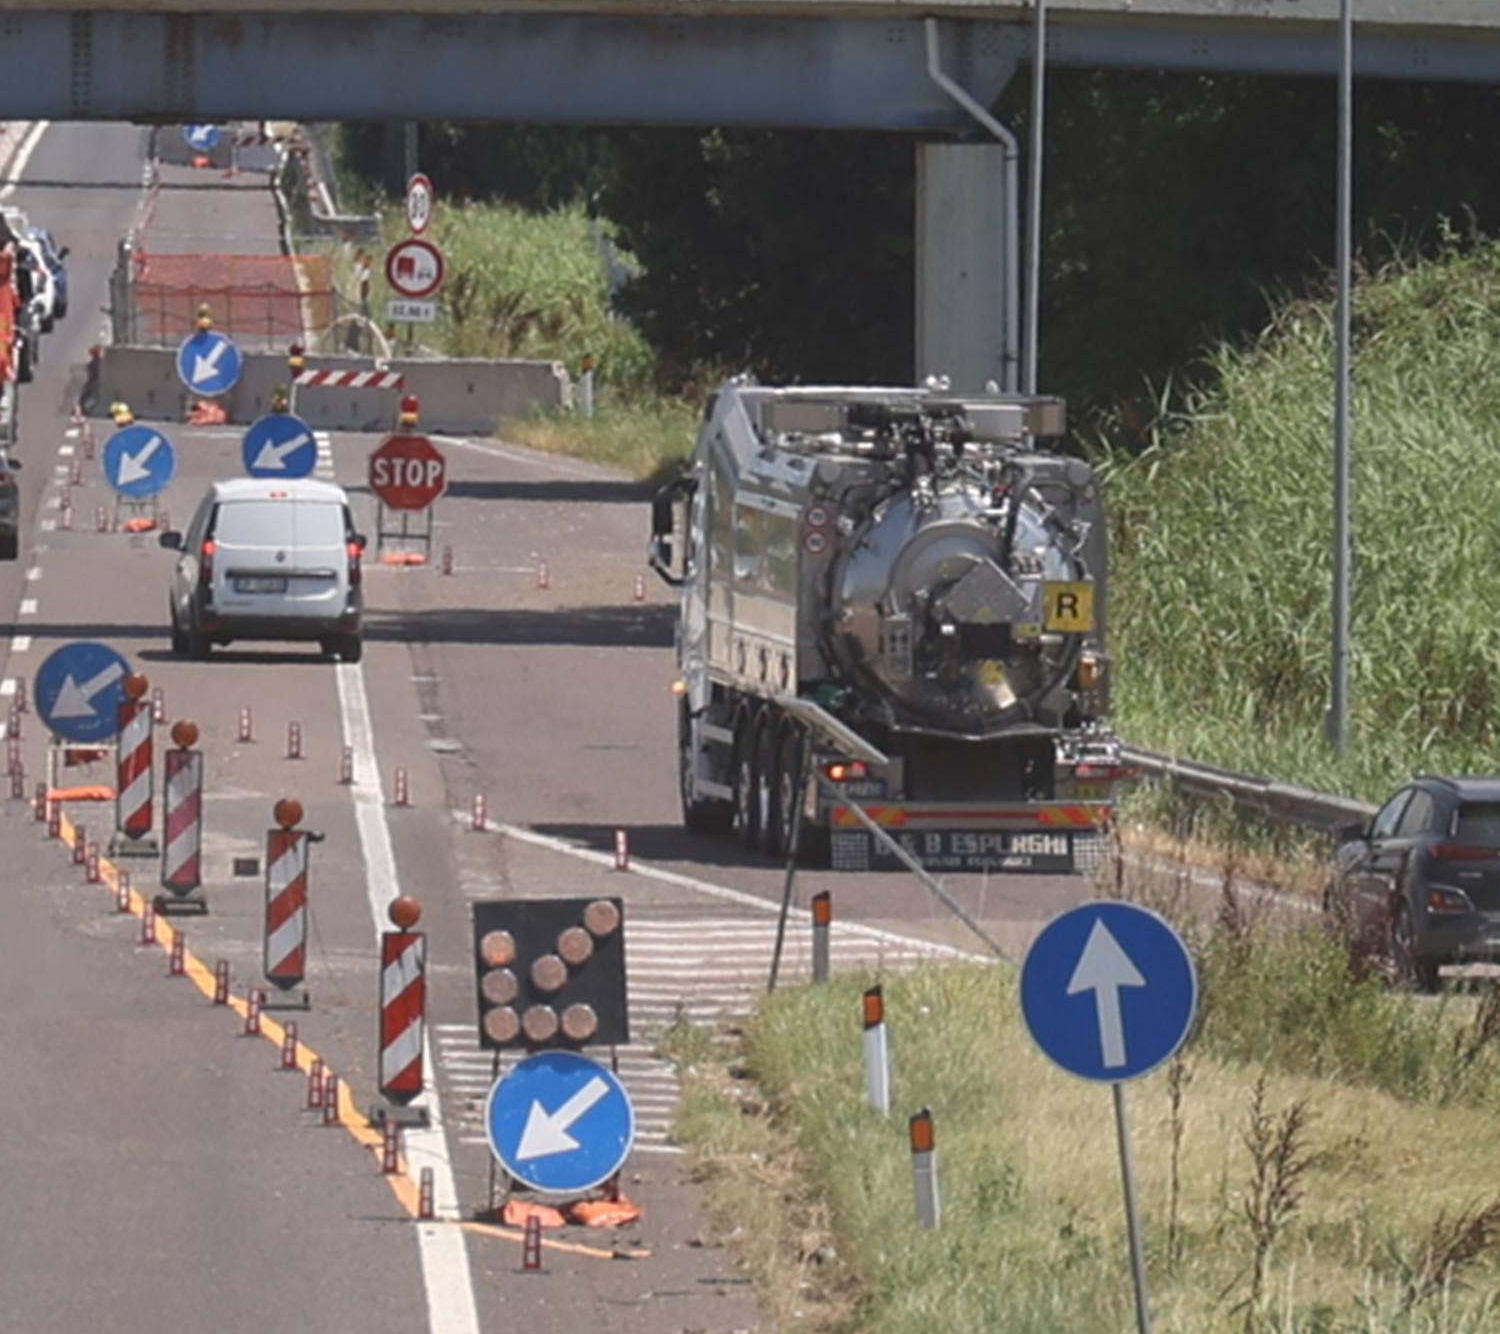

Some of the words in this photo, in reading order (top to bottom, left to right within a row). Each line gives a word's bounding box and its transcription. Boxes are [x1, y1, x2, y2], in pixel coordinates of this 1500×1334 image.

[374, 456, 441, 487] STOP
[1056, 593, 1078, 619] R
[925, 833, 941, 854] B
